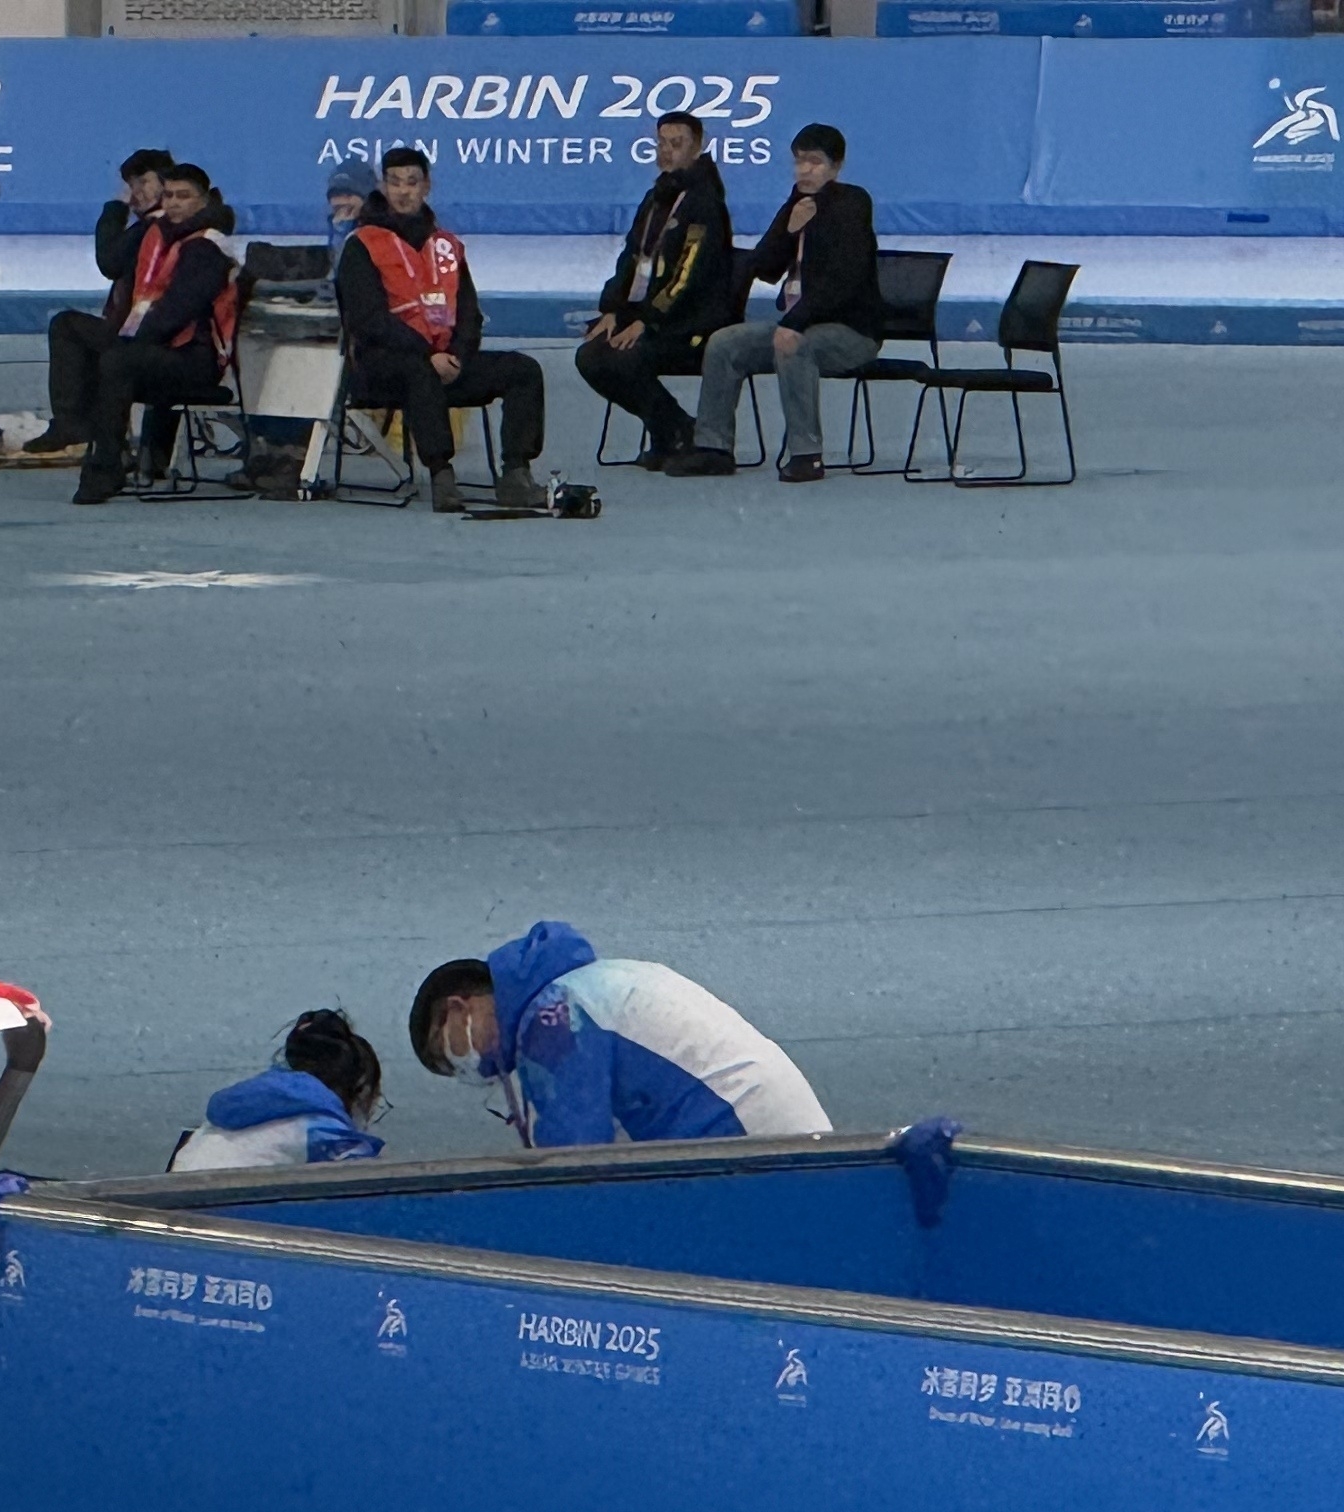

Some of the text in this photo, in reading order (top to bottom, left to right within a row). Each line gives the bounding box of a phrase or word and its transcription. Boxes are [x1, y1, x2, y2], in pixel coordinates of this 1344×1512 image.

[315, 75, 780, 127] HARBIN 2025
[457, 138, 613, 164] WINTER
[518, 1313, 662, 1361] HARBIN 2025
